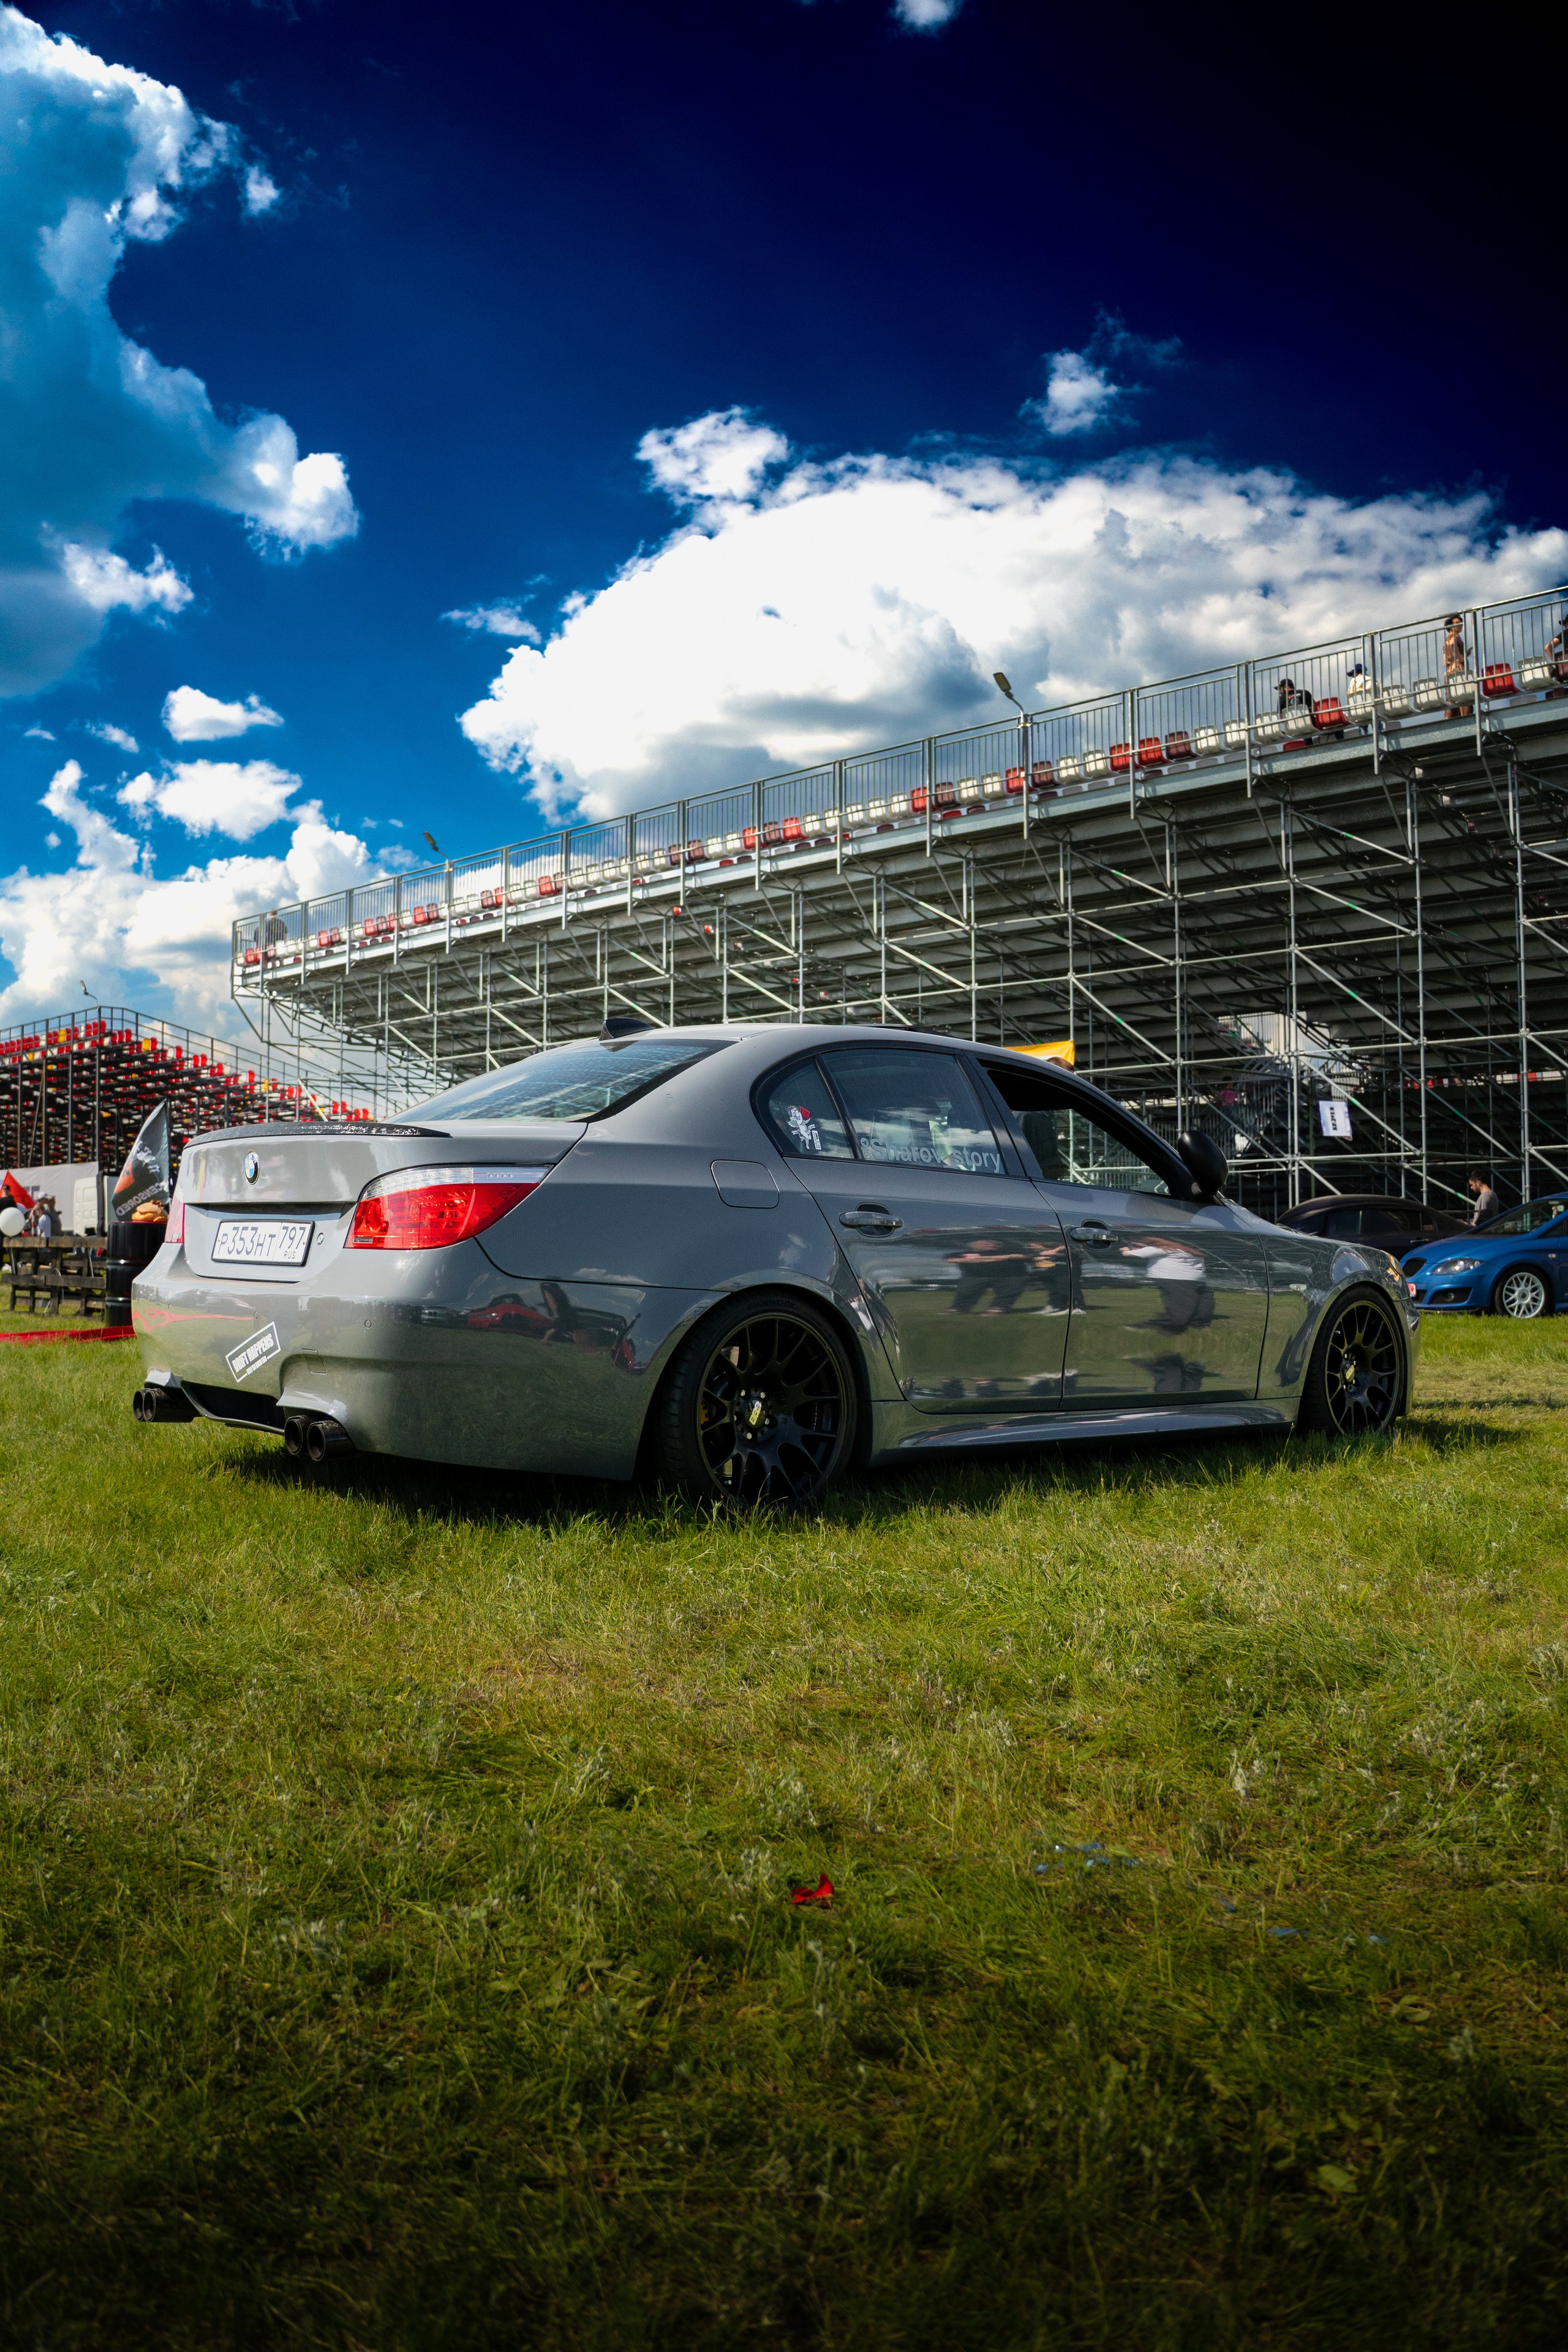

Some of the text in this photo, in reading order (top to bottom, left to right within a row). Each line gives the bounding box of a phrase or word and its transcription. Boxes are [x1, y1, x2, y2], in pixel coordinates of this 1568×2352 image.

[870, 1138, 1000, 1174] Sharov_story
[279, 1226, 306, 1250] 797
[283, 1250, 296, 1259] RUS
[232, 1351, 249, 1373] DRIFT
[246, 1333, 274, 1362] HAPPENS
